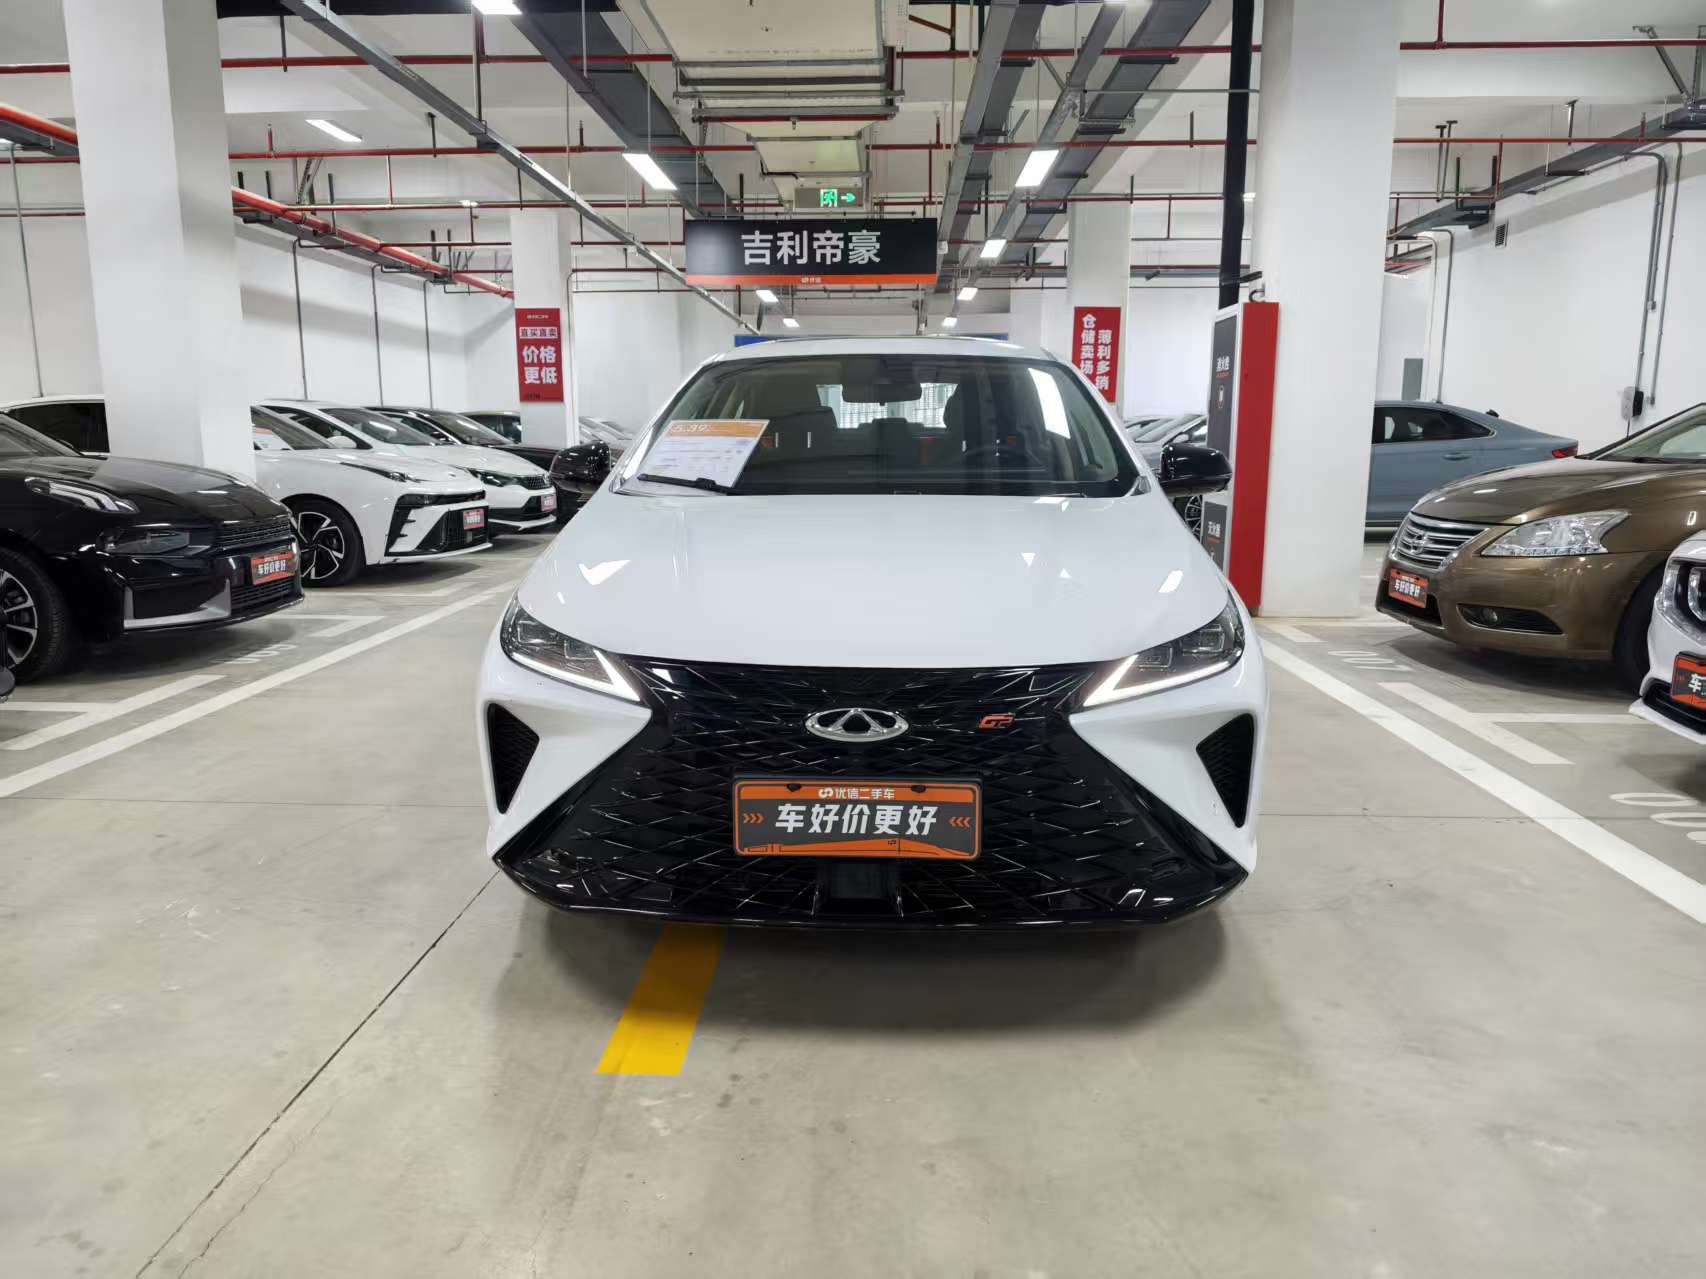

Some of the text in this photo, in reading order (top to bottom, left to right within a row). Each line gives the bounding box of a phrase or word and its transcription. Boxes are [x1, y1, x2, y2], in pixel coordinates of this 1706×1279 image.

[741, 230, 881, 265] 吉利帝豪
[522, 345, 556, 363] 价格
[1080, 313, 1097, 375] 仓储卖场
[1096, 329, 1112, 390] 薄利多销
[524, 366, 557, 384] 更低
[775, 803, 938, 836] 车好价更好
